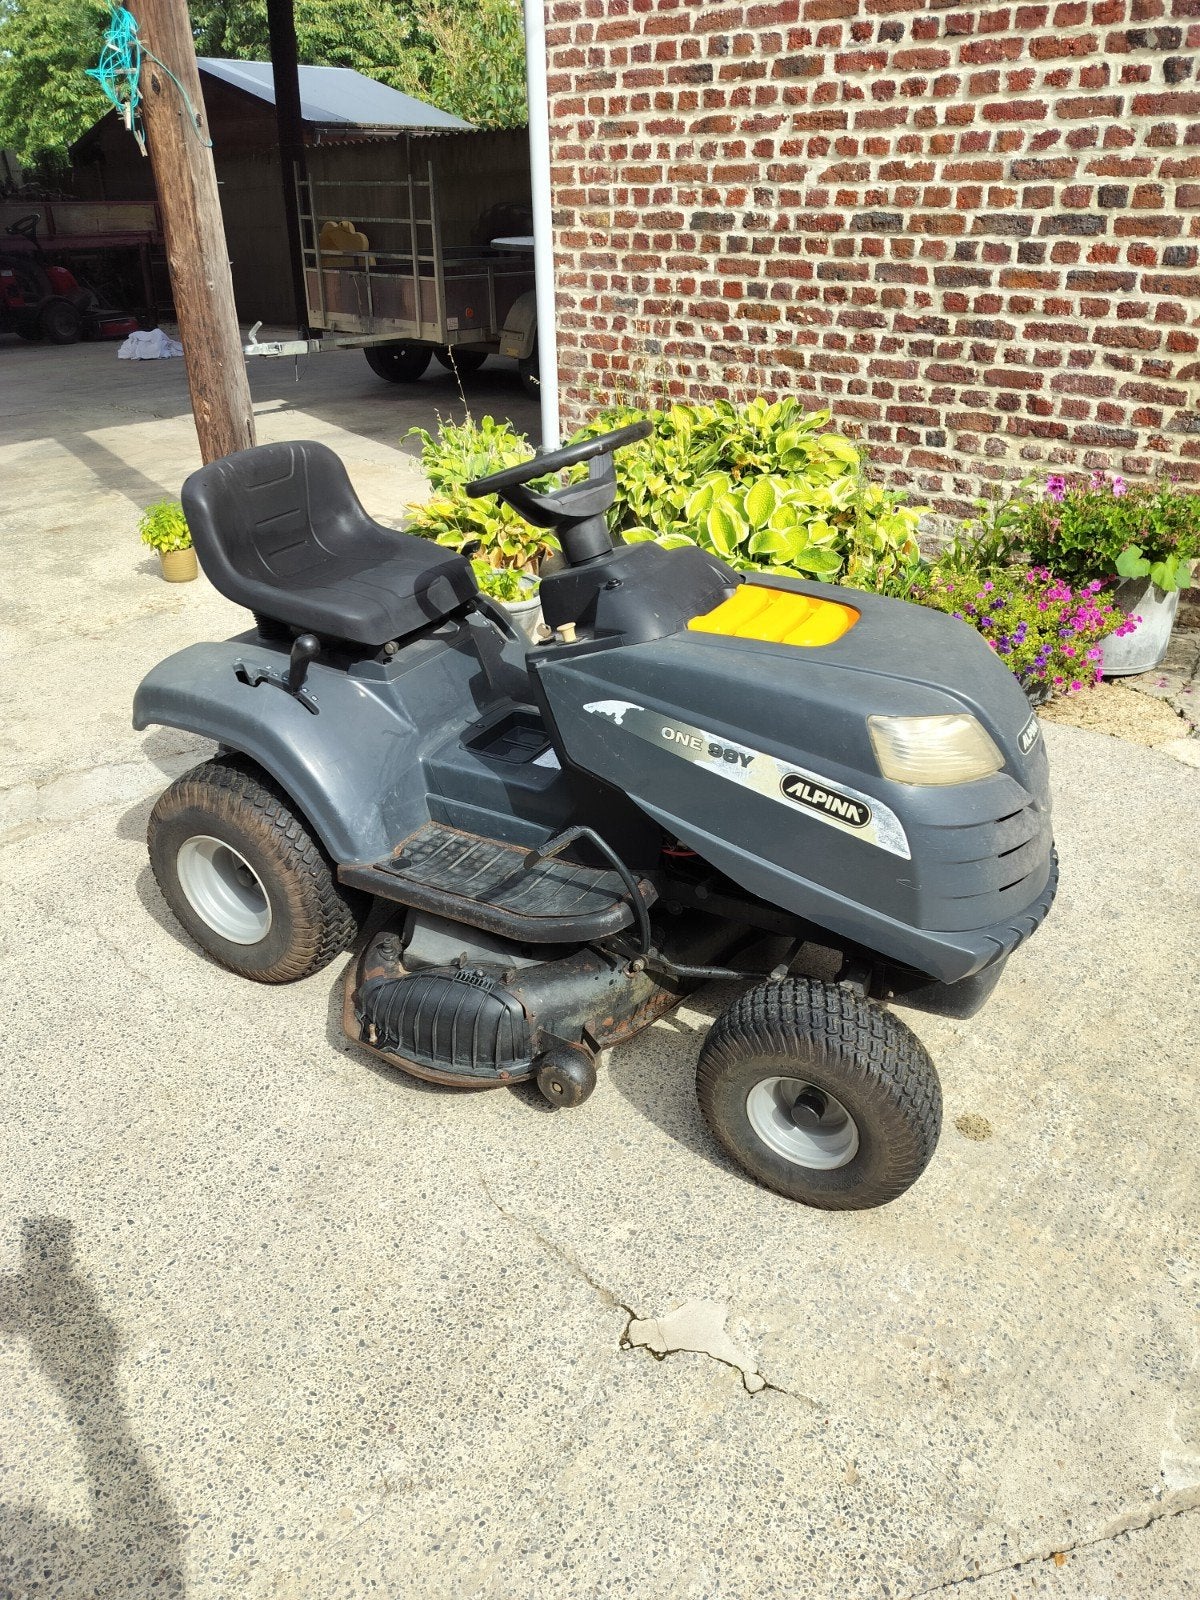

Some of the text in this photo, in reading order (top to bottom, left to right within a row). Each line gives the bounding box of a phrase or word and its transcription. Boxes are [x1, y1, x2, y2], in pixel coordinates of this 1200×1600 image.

[661, 726, 755, 769] ONE 98Y
[785, 781, 862, 823] ALPINA
